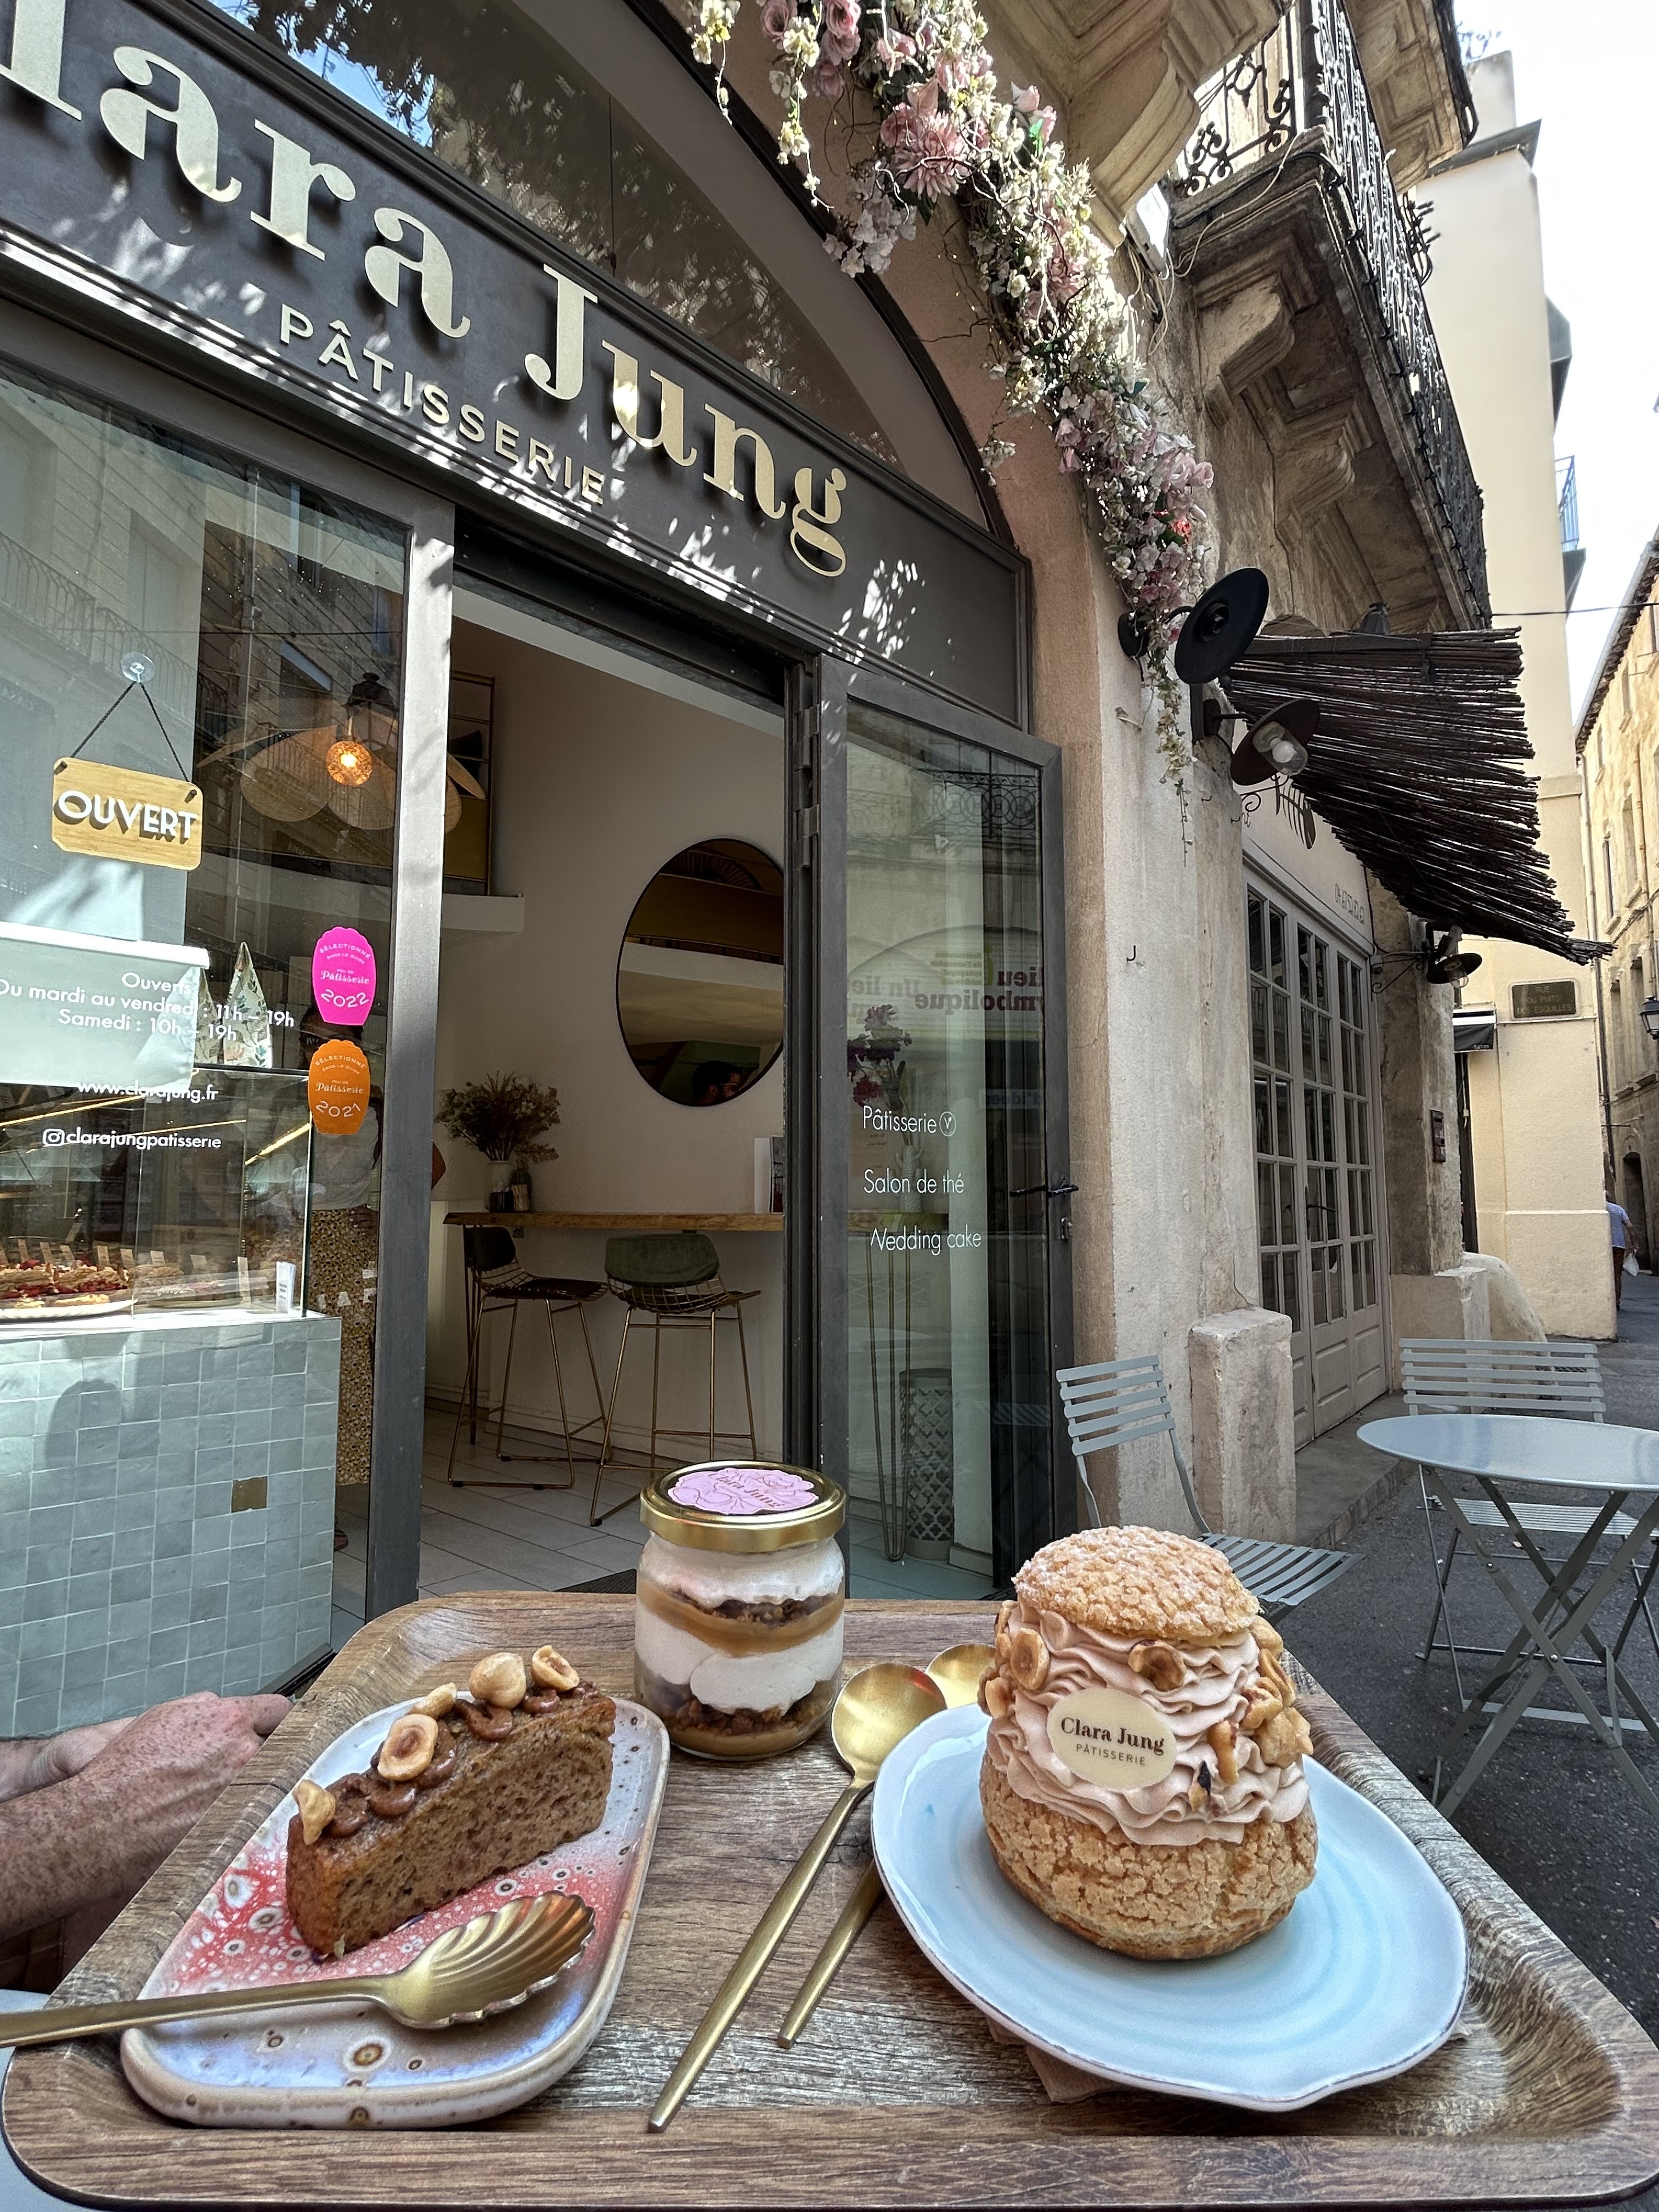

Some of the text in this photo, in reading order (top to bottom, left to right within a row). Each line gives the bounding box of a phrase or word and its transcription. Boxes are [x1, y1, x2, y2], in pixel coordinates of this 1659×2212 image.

[280, 303, 604, 505] PÂTISSERIE
[524, 264, 847, 577] Jung
[57, 790, 198, 839] OUVERT
[122, 972, 192, 995] Ouverts
[29, 987, 86, 1003] mardi
[91, 994, 115, 1007] au
[217, 1004, 243, 1022] 11h
[268, 1009, 295, 1028] 19h
[320, 989, 370, 1008] 2022
[58, 1008, 131, 1030] Samedi
[150, 1017, 182, 1036] 10h
[208, 1024, 237, 1041] 19h
[315, 1100, 362, 1118] 2021
[863, 1105, 937, 1134] Pâtisserie
[66, 1127, 222, 1150] clarajungpatisserie
[864, 1167, 964, 1193] Salon de thé
[946, 1224, 981, 1248] cake
[1060, 1717, 1165, 1756] Clara Jung
[1075, 1743, 1147, 1765] PÂTISSERIE
